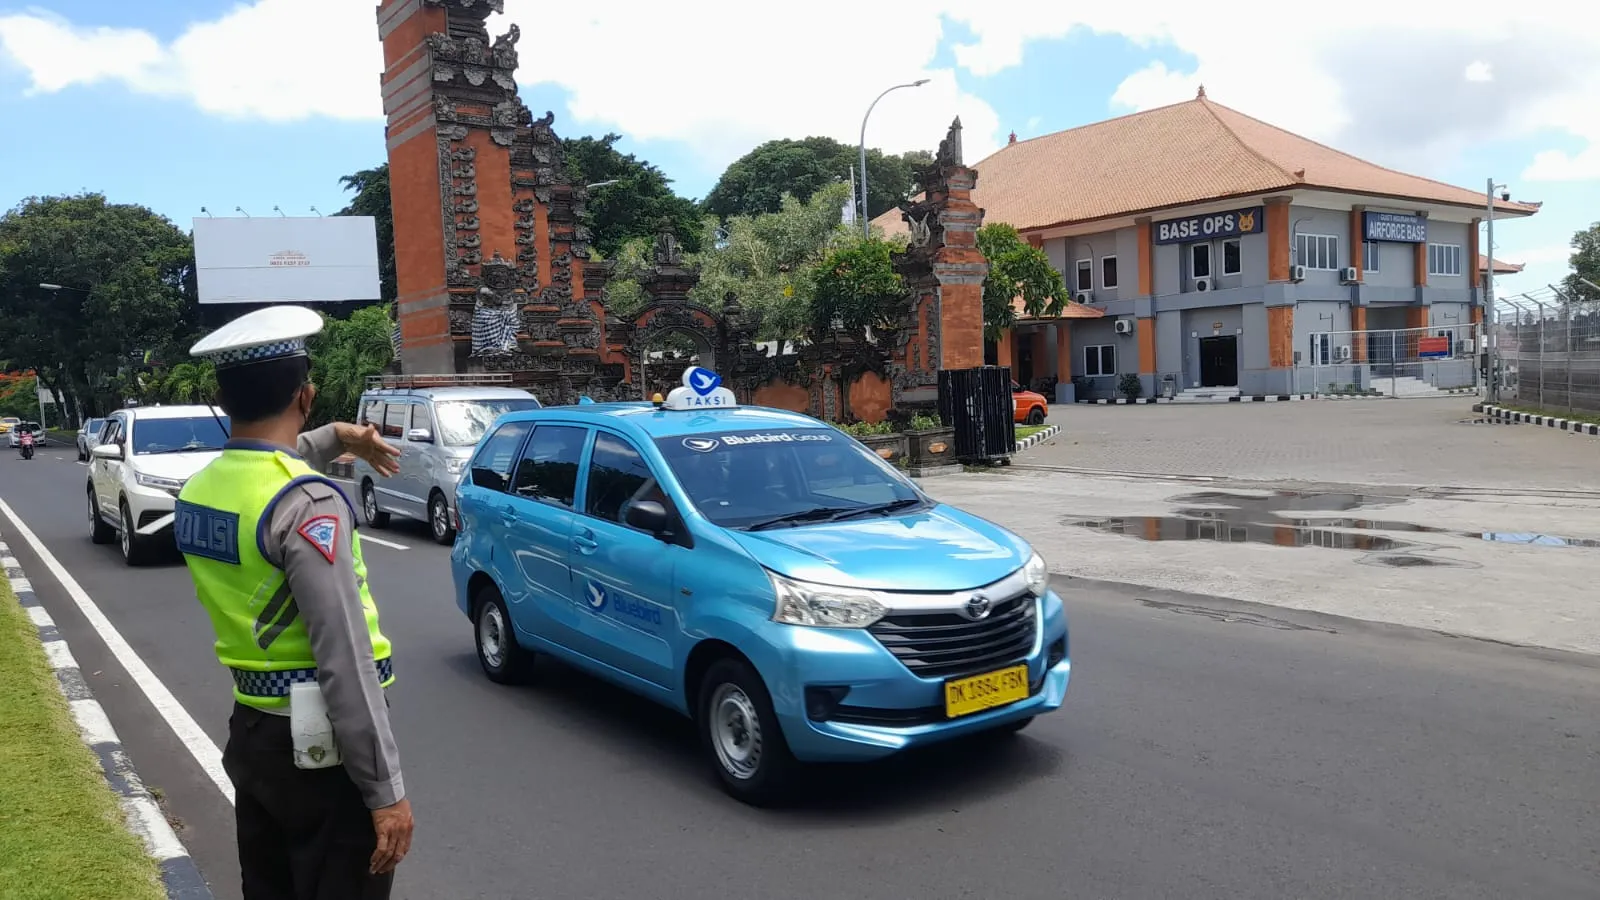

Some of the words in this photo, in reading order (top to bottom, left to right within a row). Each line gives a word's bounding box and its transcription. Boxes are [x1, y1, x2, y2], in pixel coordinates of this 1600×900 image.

[1160, 219, 1199, 240] BASE
[1203, 214, 1235, 234] OPS
[1369, 220, 1406, 239] AIRFORCE
[1407, 225, 1425, 240] BASE
[686, 396, 726, 406] TAKSI
[721, 432, 792, 446] Bluebird
[792, 433, 832, 442] Group
